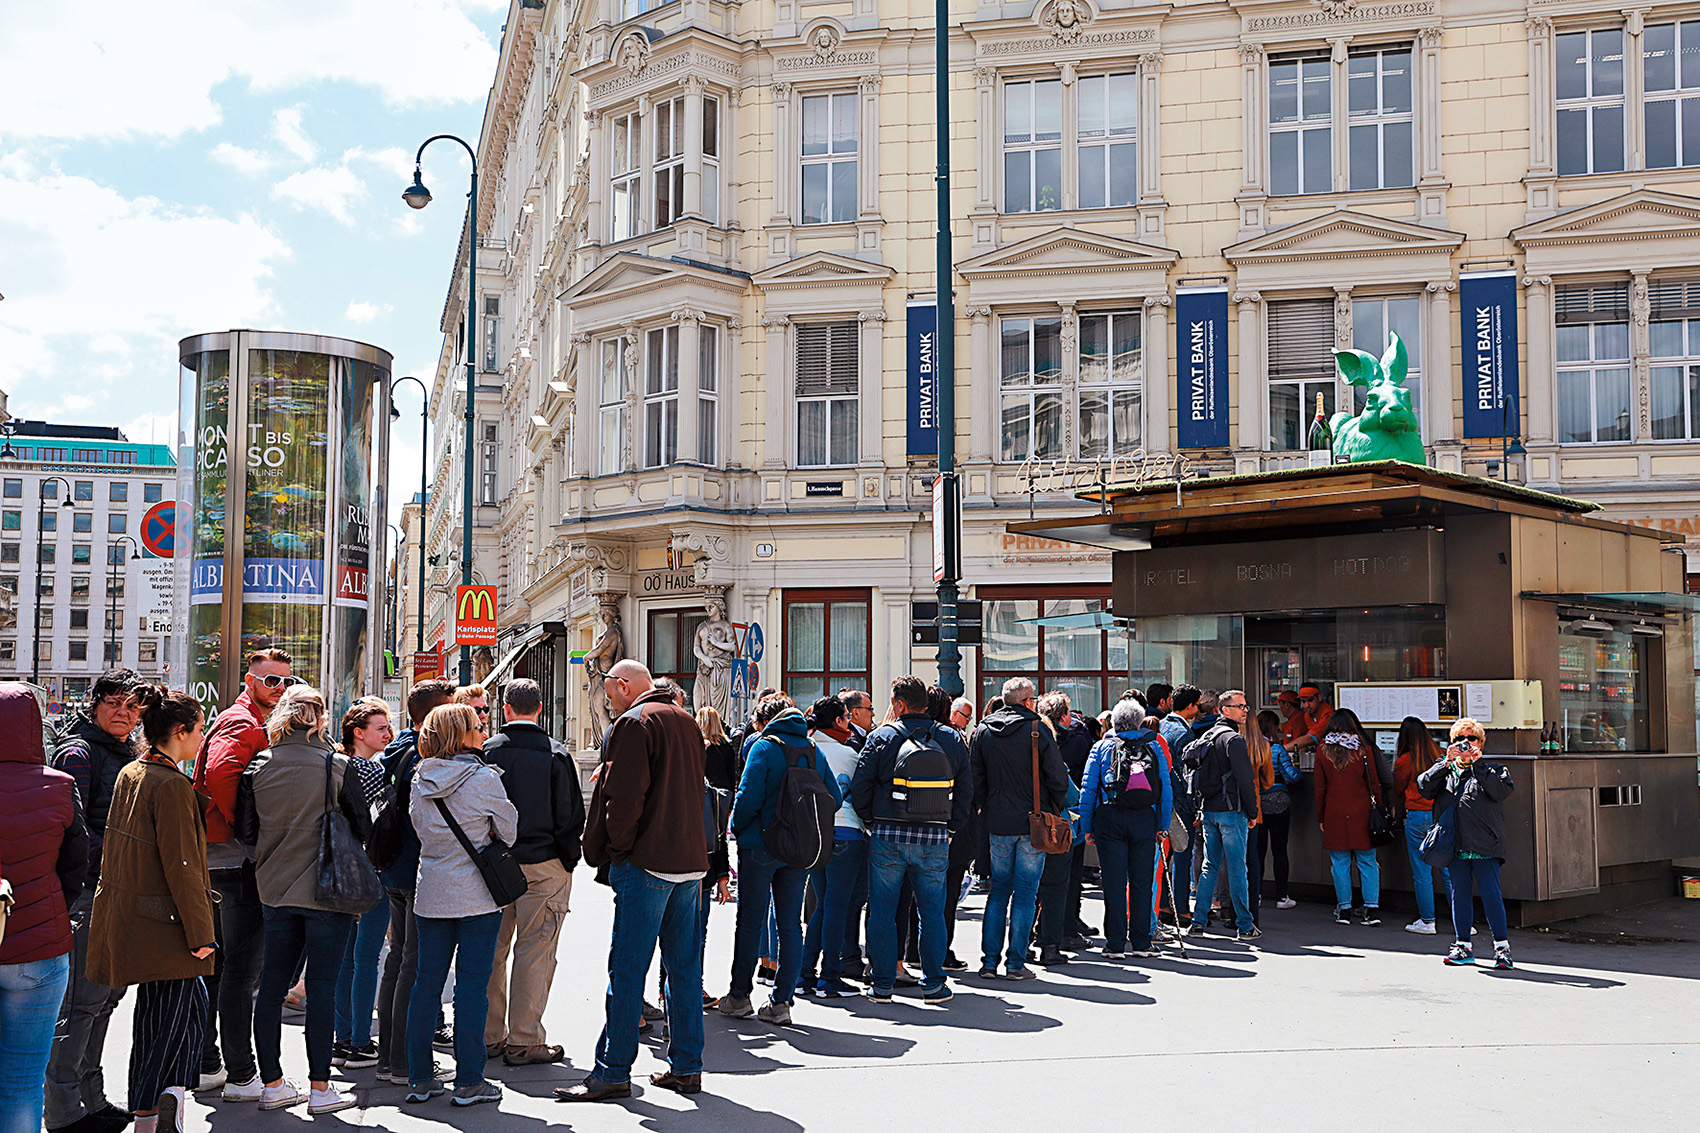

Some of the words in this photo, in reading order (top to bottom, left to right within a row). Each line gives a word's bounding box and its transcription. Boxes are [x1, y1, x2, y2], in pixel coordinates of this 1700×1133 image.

[1190, 320, 1204, 363] BANK
[1476, 305, 1491, 351] BANK
[919, 332, 932, 373] BANK
[919, 376, 932, 429] PRIVAT
[1191, 367, 1205, 421] PRIVAT
[1477, 354, 1493, 410] PRIVAT
[266, 432, 292, 445] BIS
[41, 464, 132, 475] OPERNRINGHOF
[643, 572, 661, 592] OÖ
[665, 574, 696, 590] HAUS
[1237, 563, 1291, 581] BOSNA
[1334, 558, 1369, 576] HOT
[457, 625, 496, 634] Karlsplatz
